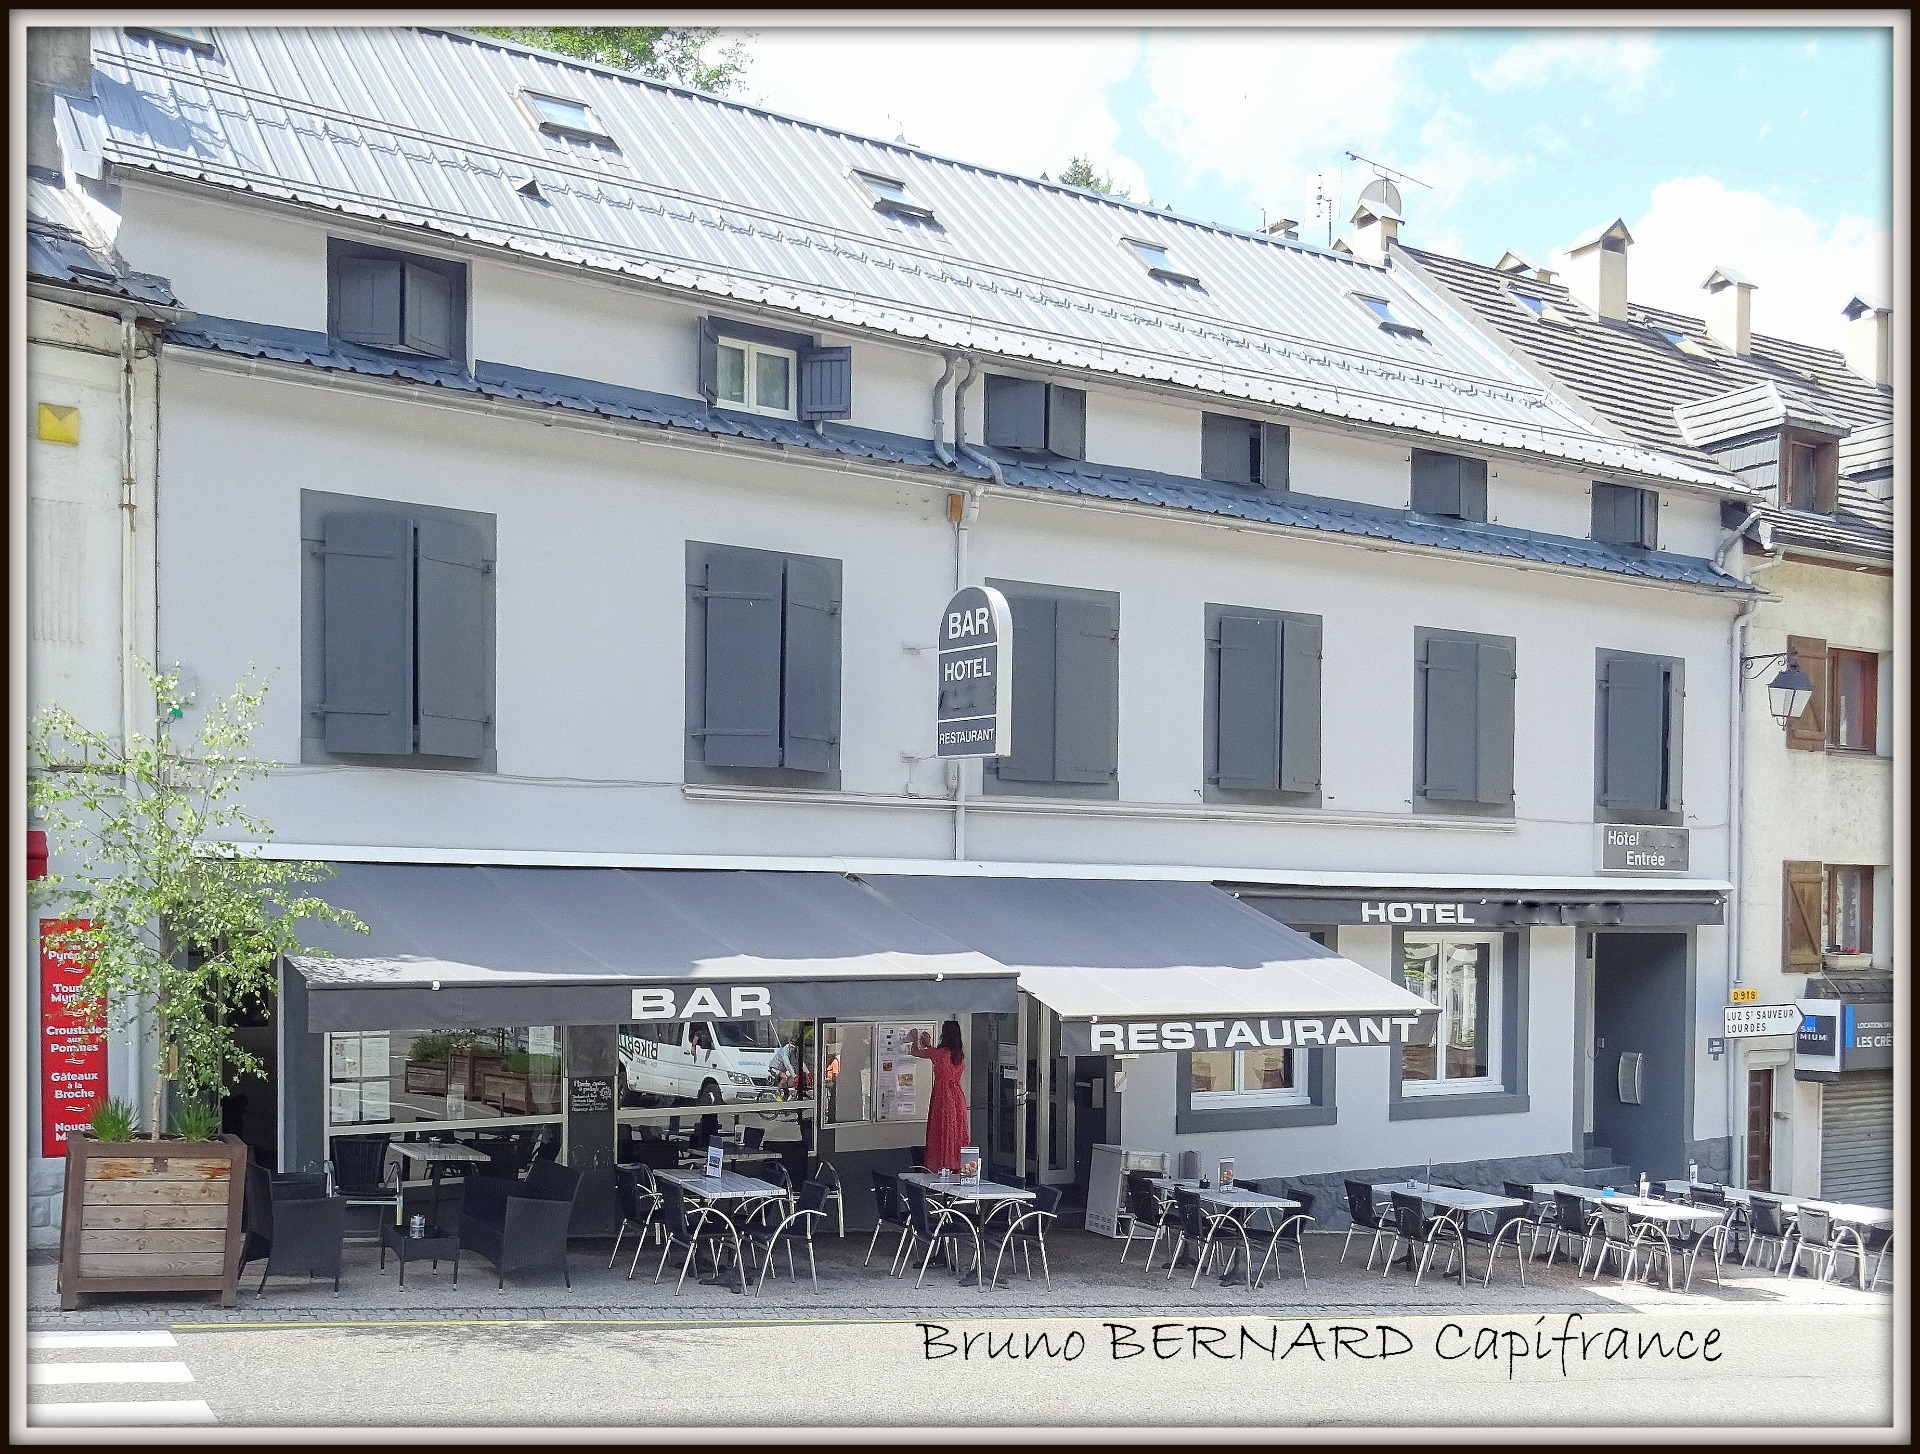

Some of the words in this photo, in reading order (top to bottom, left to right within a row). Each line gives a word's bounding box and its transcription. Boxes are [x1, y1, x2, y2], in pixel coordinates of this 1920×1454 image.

[948, 607, 989, 640] BAR
[944, 657, 992, 682] HOTEL
[939, 728, 995, 745] RESTAURANT
[1607, 830, 1640, 846] Hôtel
[1626, 850, 1666, 866] Entrée
[1361, 902, 1475, 924] HOTEL
[48, 949, 99, 962] Pyrénes
[631, 986, 772, 1020] BAR
[1726, 1011, 1742, 1021] LUZ
[1756, 1009, 1794, 1020] SAUVEUR
[1091, 1017, 1419, 1051] RESTAURANT
[1727, 1022, 1767, 1034] LOURDES
[1800, 1025, 1816, 1033] SKI
[1856, 1035, 1872, 1048] LES
[51, 1071, 99, 1081] Gâteaux
[67, 1081, 73, 1089] à
[74, 1081, 83, 1089] la
[54, 1090, 95, 1099] Broche
[55, 1123, 95, 1133] Nouga
